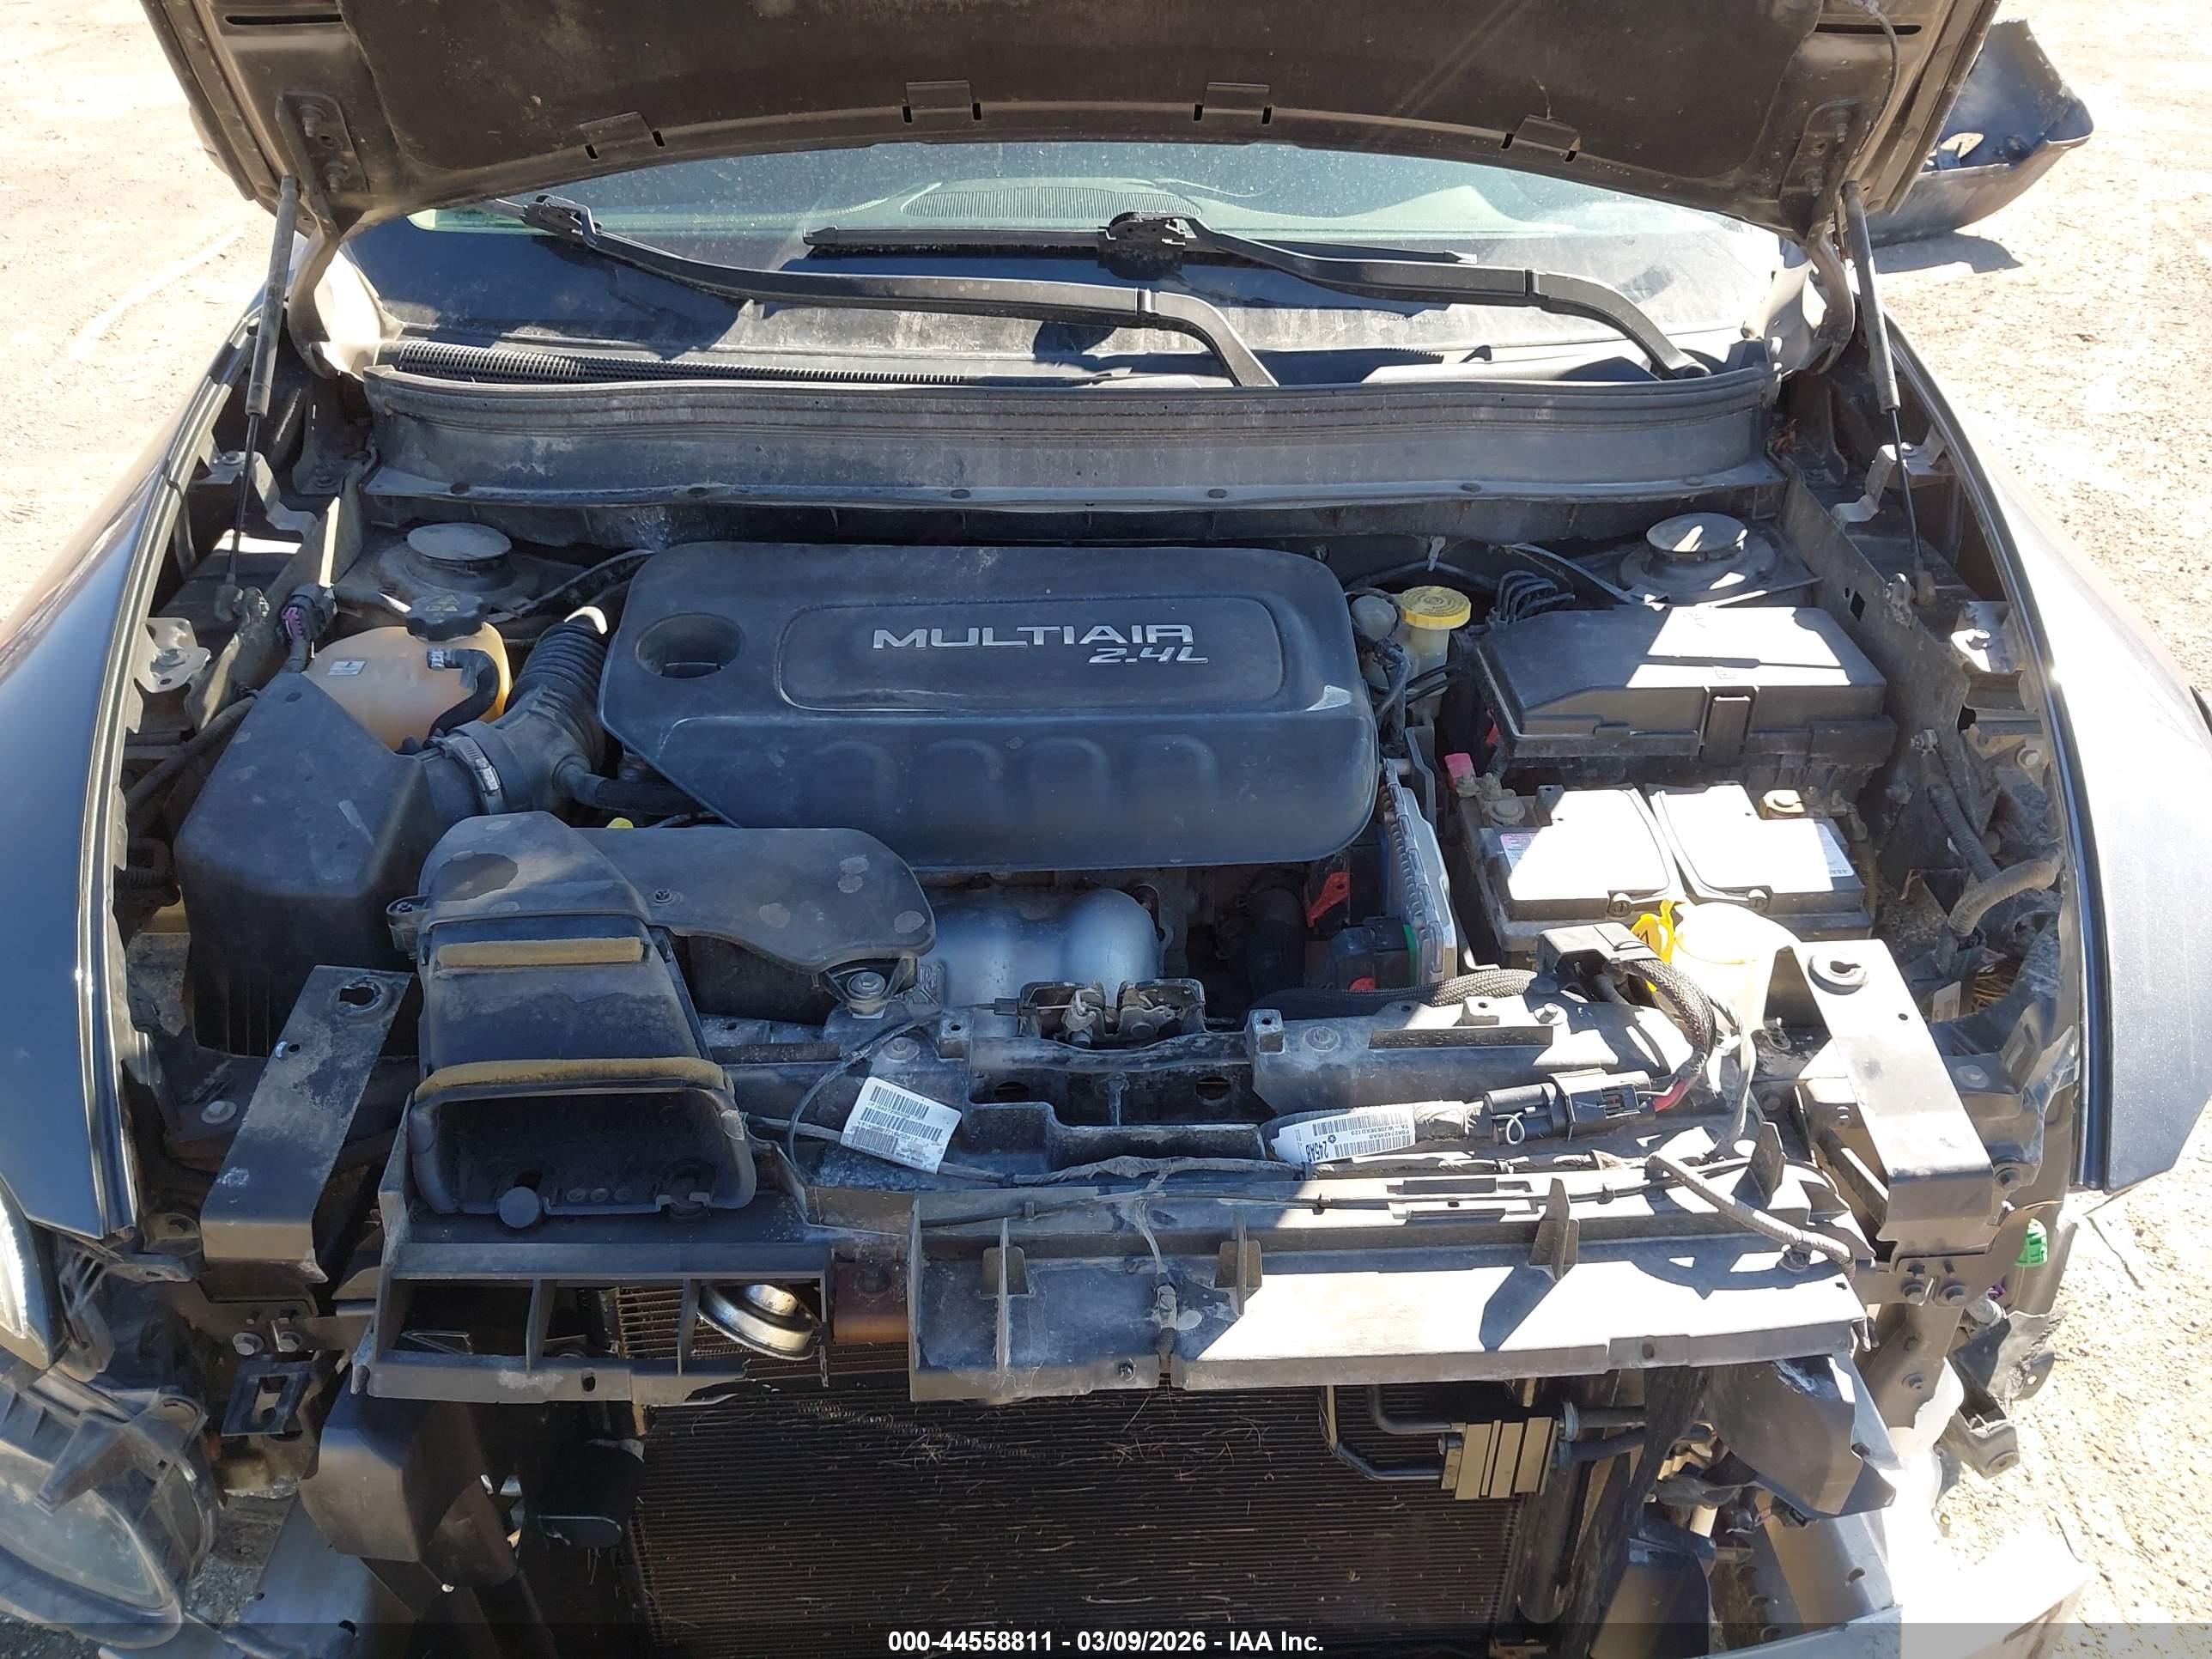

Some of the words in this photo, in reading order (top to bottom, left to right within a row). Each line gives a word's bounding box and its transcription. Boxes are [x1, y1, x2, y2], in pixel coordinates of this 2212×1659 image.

[872, 624, 1194, 650] MULTIAIR
[1086, 646, 1210, 665] 2.4L
[1306, 1140, 1328, 1162] 245AB
